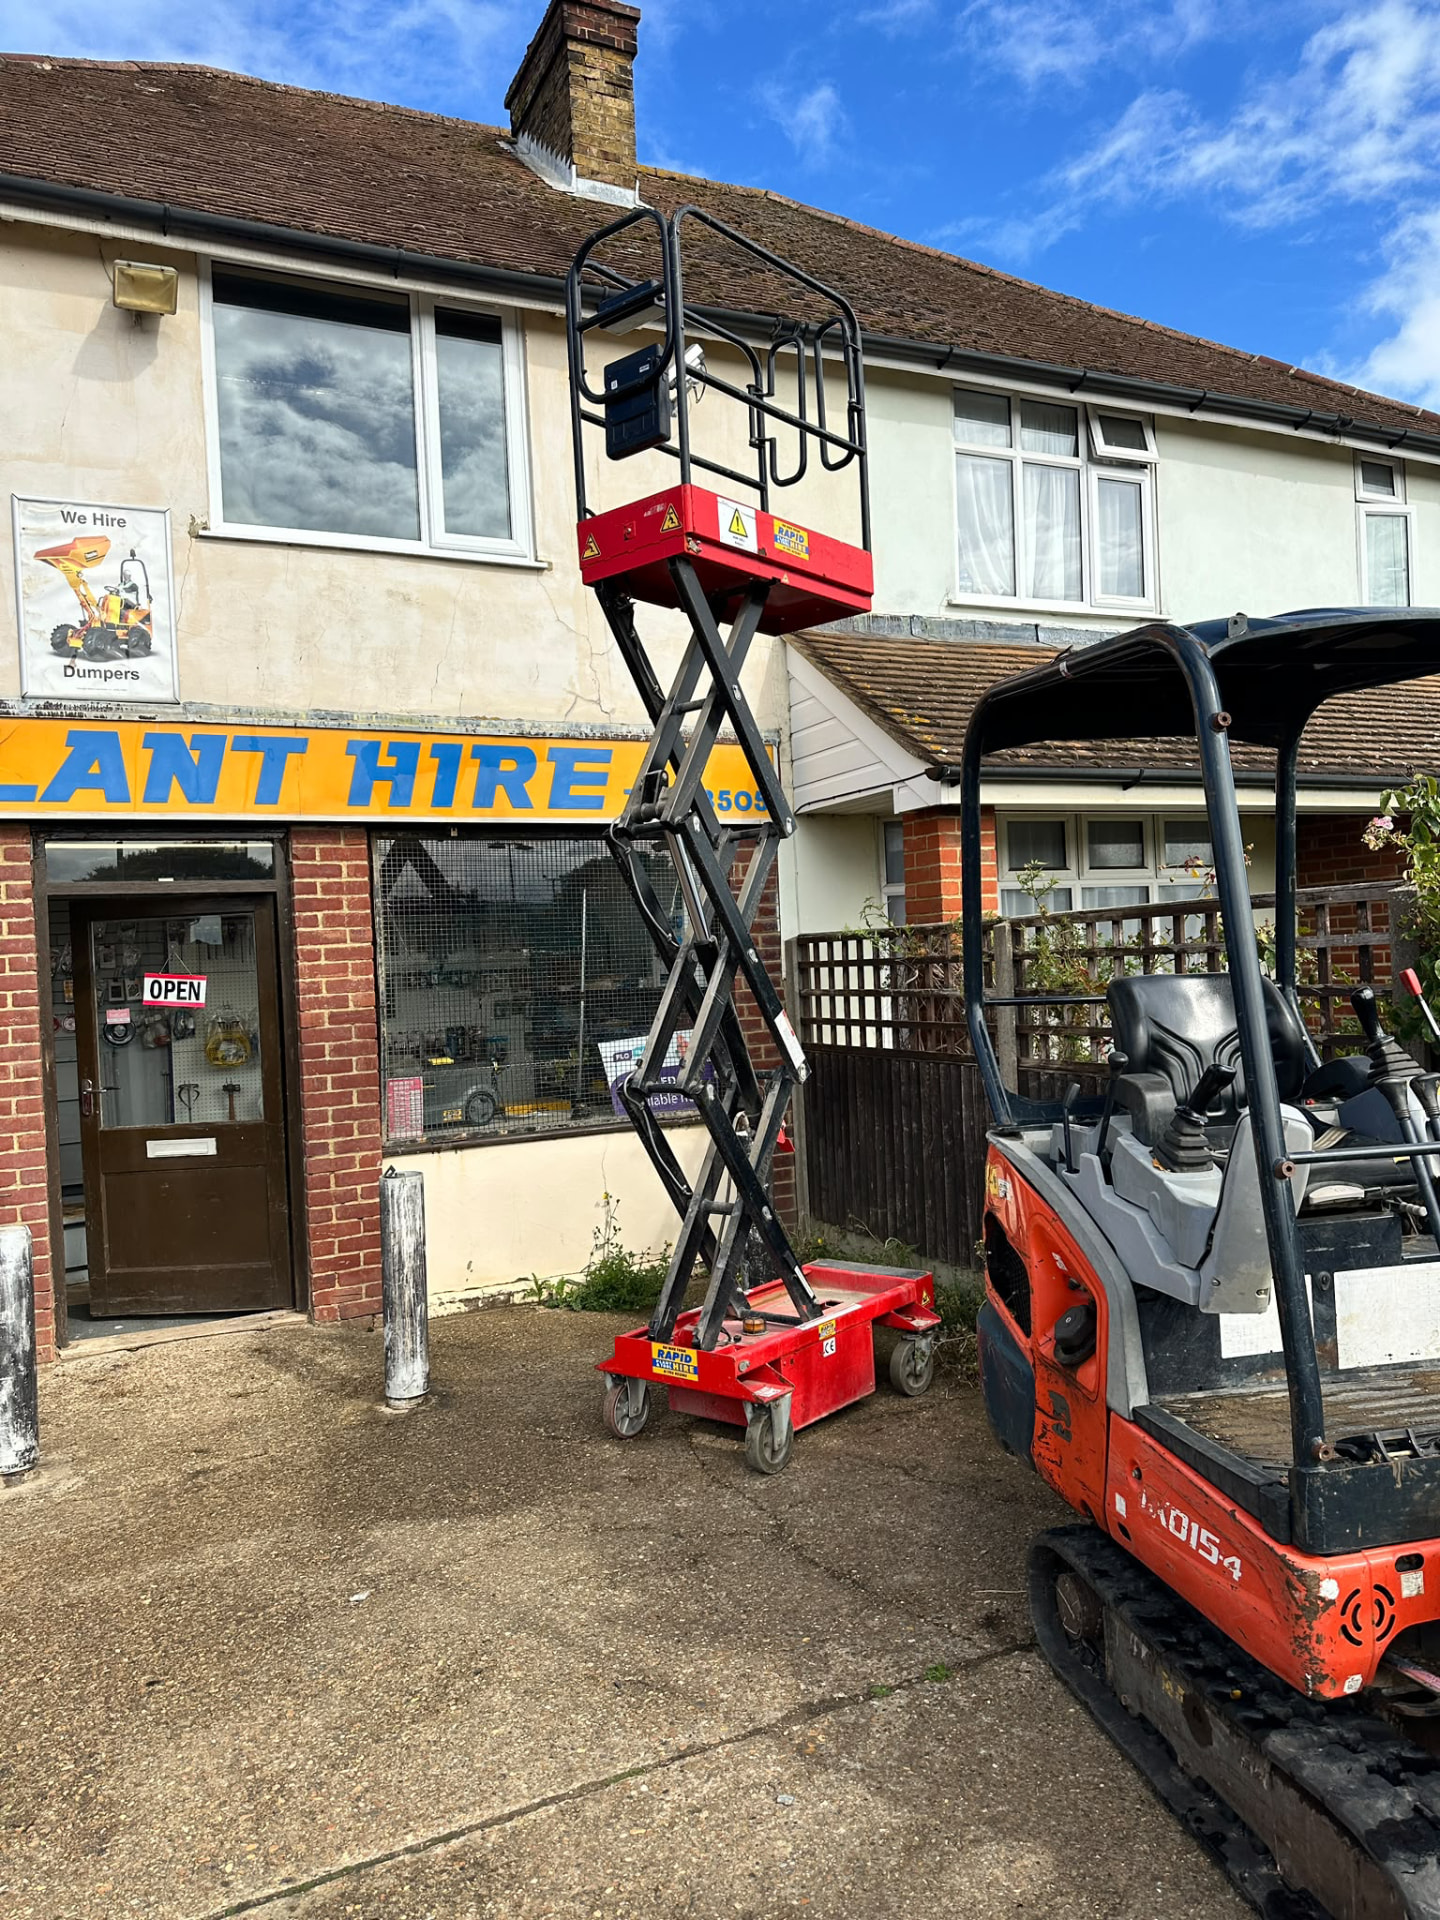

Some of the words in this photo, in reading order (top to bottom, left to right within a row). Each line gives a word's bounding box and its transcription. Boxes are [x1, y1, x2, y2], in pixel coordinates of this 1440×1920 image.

[61, 510, 87, 525] We
[93, 512, 127, 528] Hire
[778, 526, 804, 543] RAPID
[63, 664, 140, 683] Dumpers
[345, 739, 613, 810] HIRE
[150, 979, 201, 1001] OPEN
[657, 1349, 692, 1364] RAPID
[673, 1362, 695, 1375] HIRE
